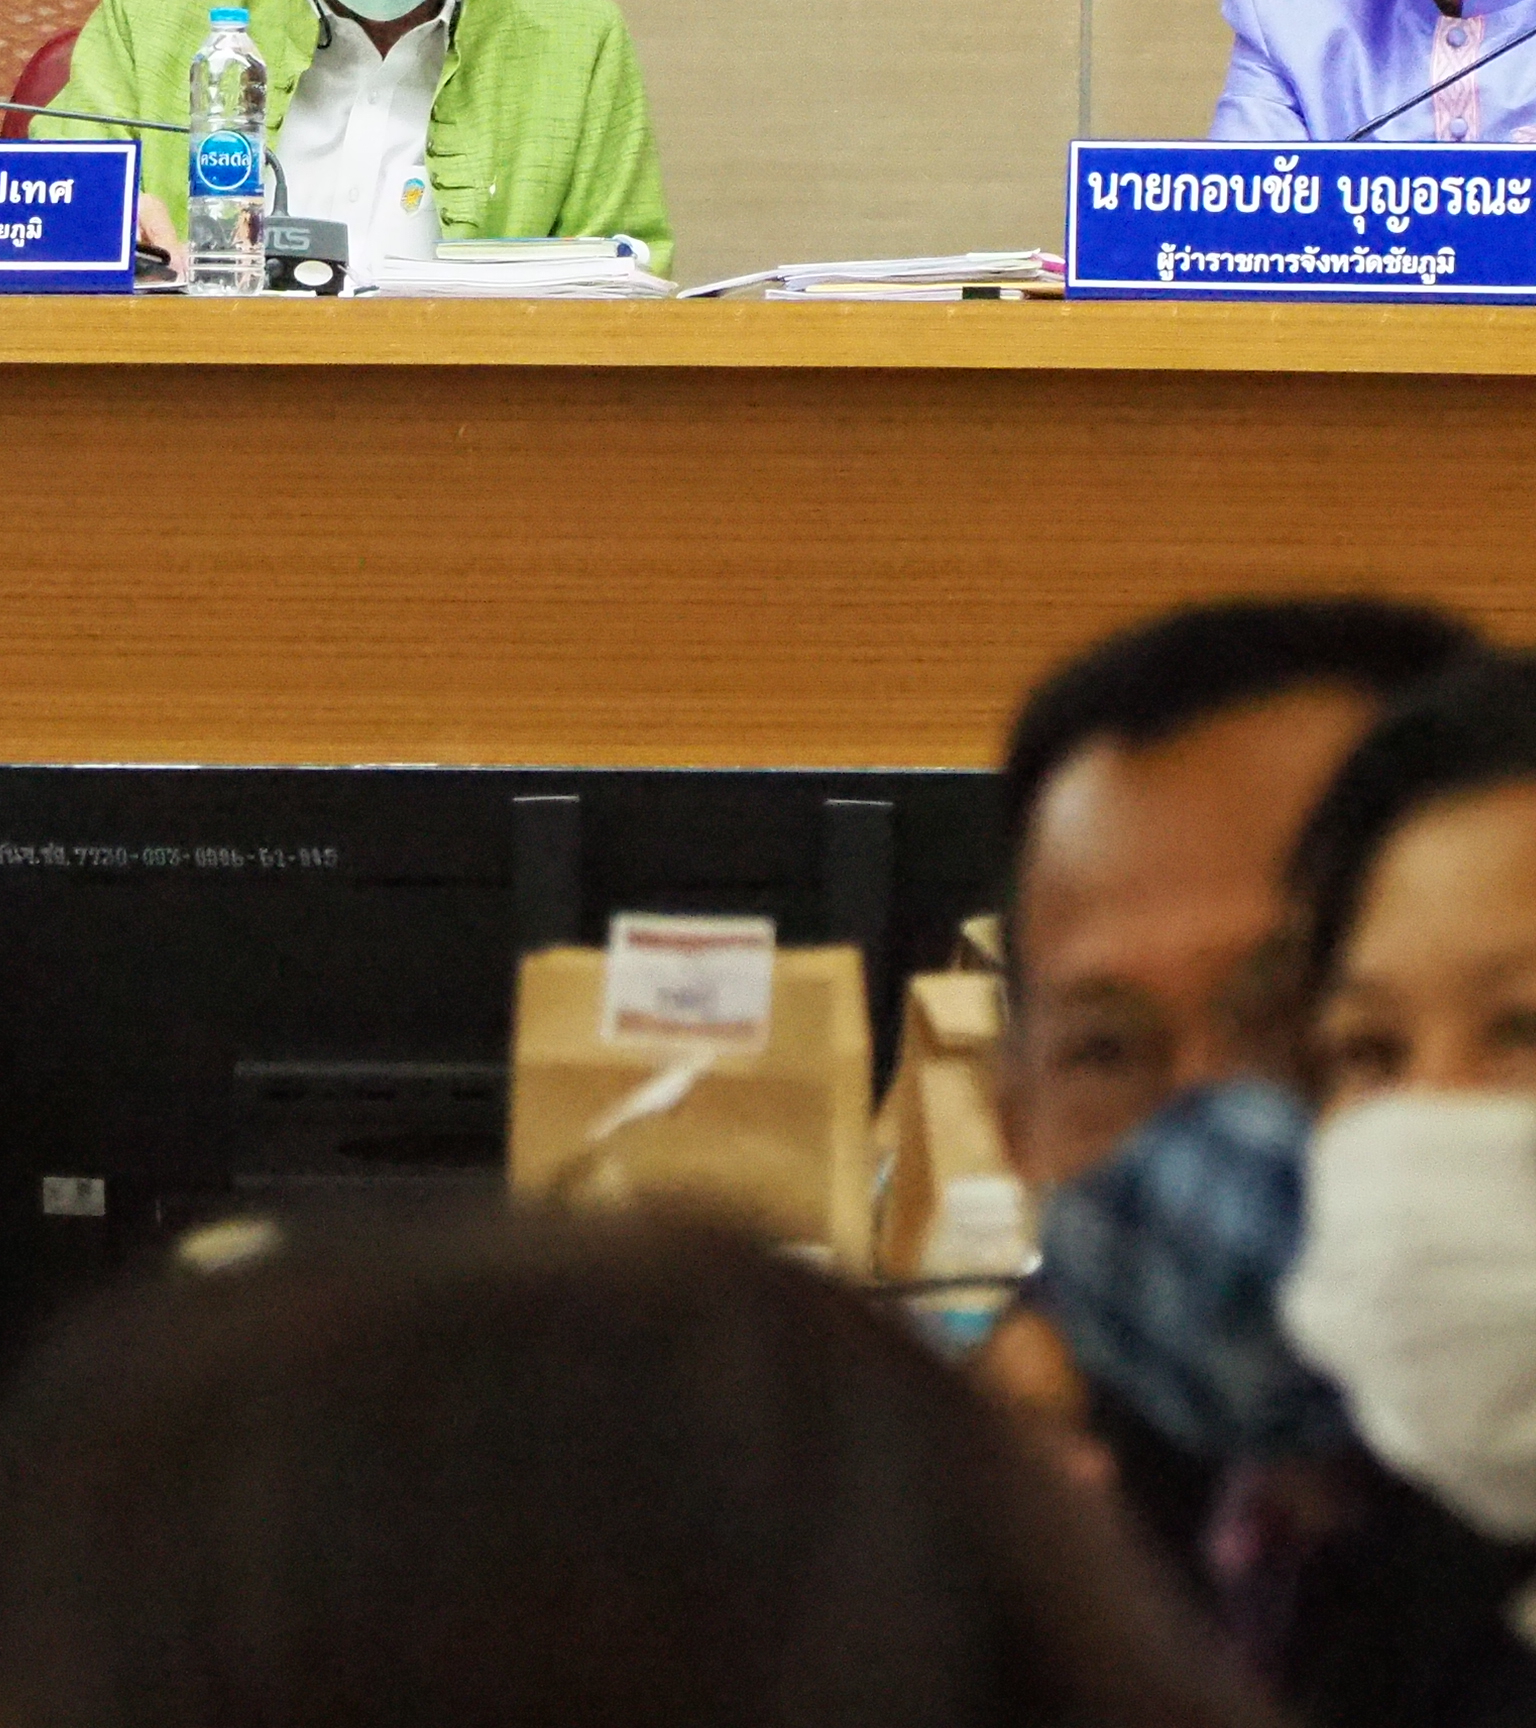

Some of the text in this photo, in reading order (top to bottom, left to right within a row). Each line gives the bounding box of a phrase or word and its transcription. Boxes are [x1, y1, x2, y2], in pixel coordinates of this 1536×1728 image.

[1087, 154, 1532, 235] นายกอบชัย บุญอรณะ
[1157, 242, 1456, 284] ผู้ว่าราชการจังหวัดชัยภูมิ
